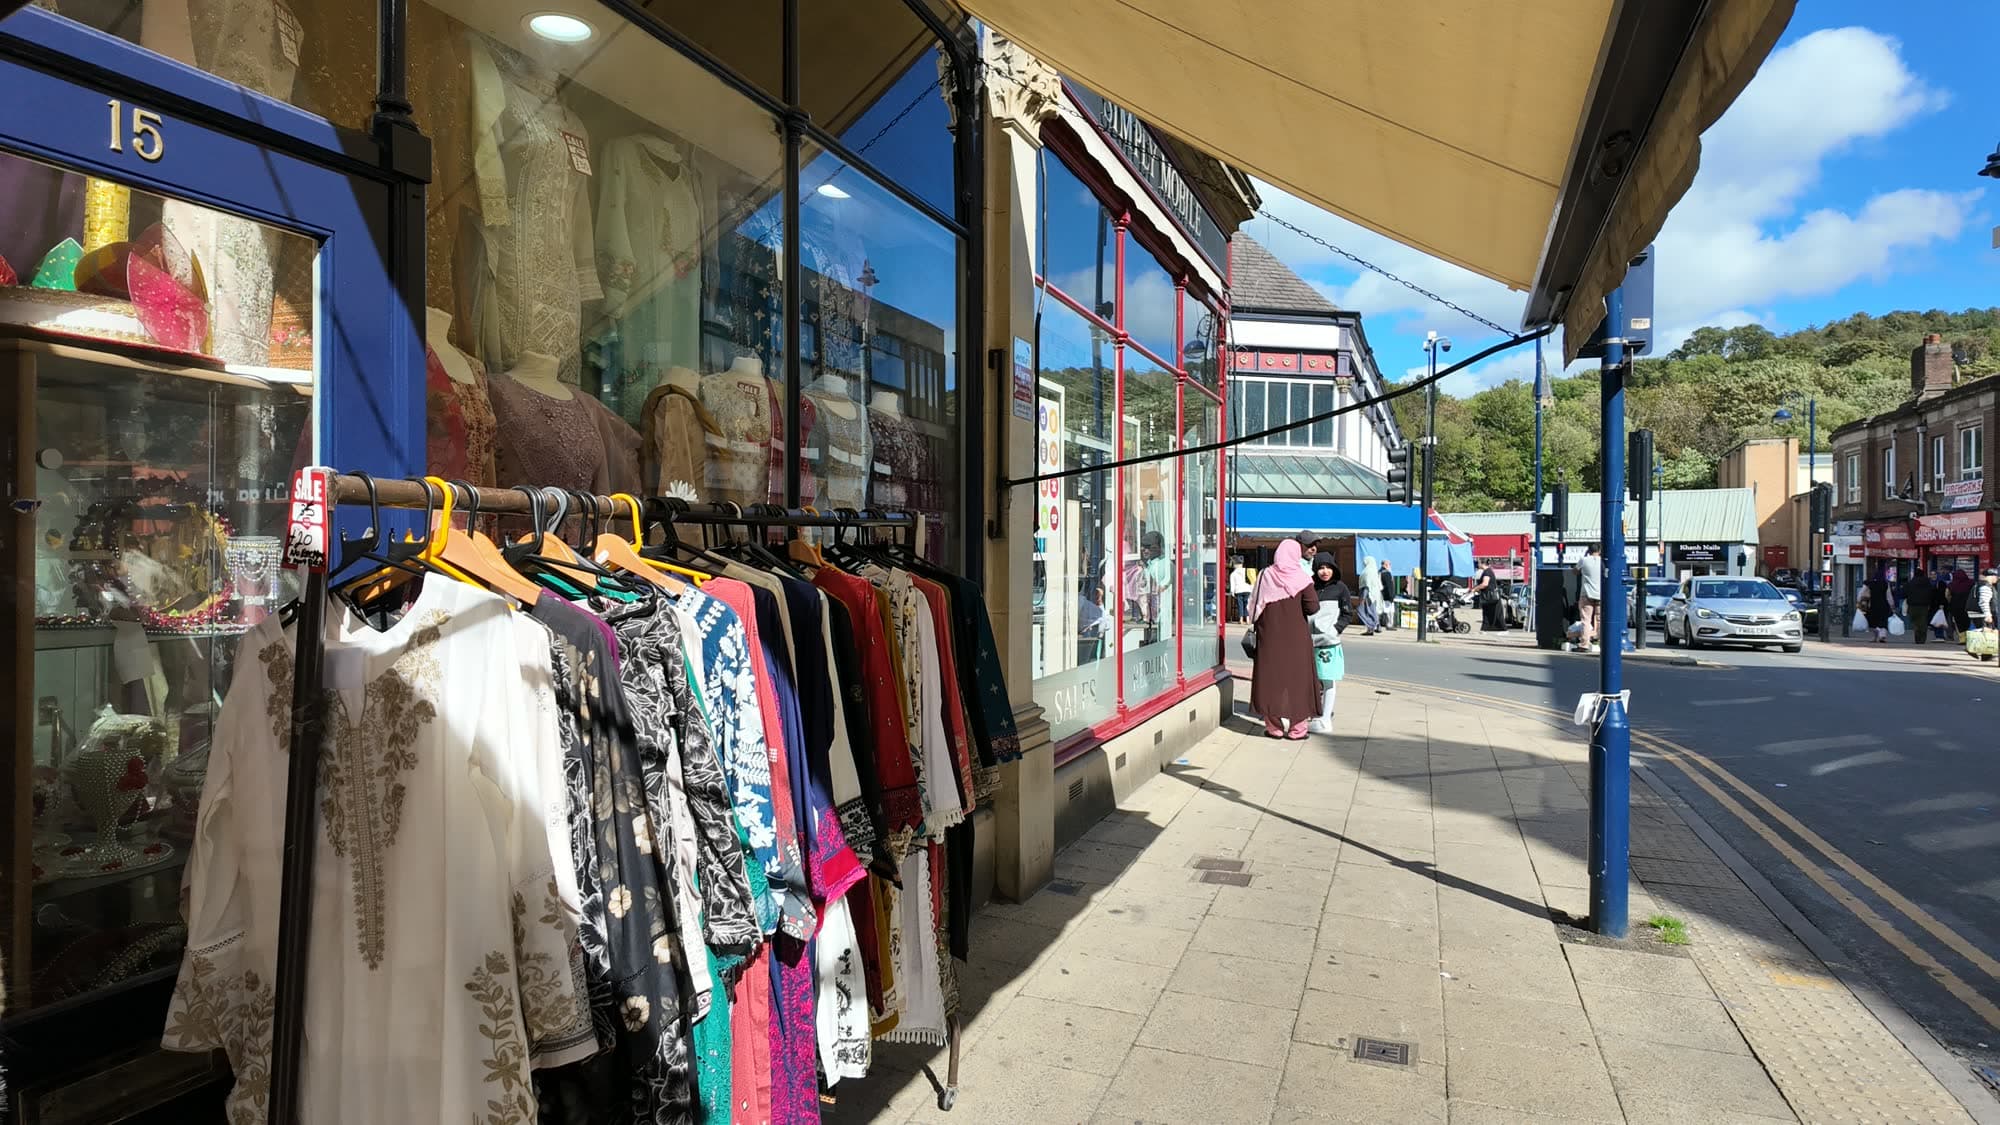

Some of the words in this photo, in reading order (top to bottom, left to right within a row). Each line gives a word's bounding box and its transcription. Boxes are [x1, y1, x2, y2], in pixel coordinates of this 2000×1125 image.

[106, 100, 164, 162] 15
[1101, 99, 1157, 178] SIMPLY
[1158, 152, 1202, 237] MOBILE
[294, 478, 323, 503] SALE
[1054, 679, 1097, 725] SALES
